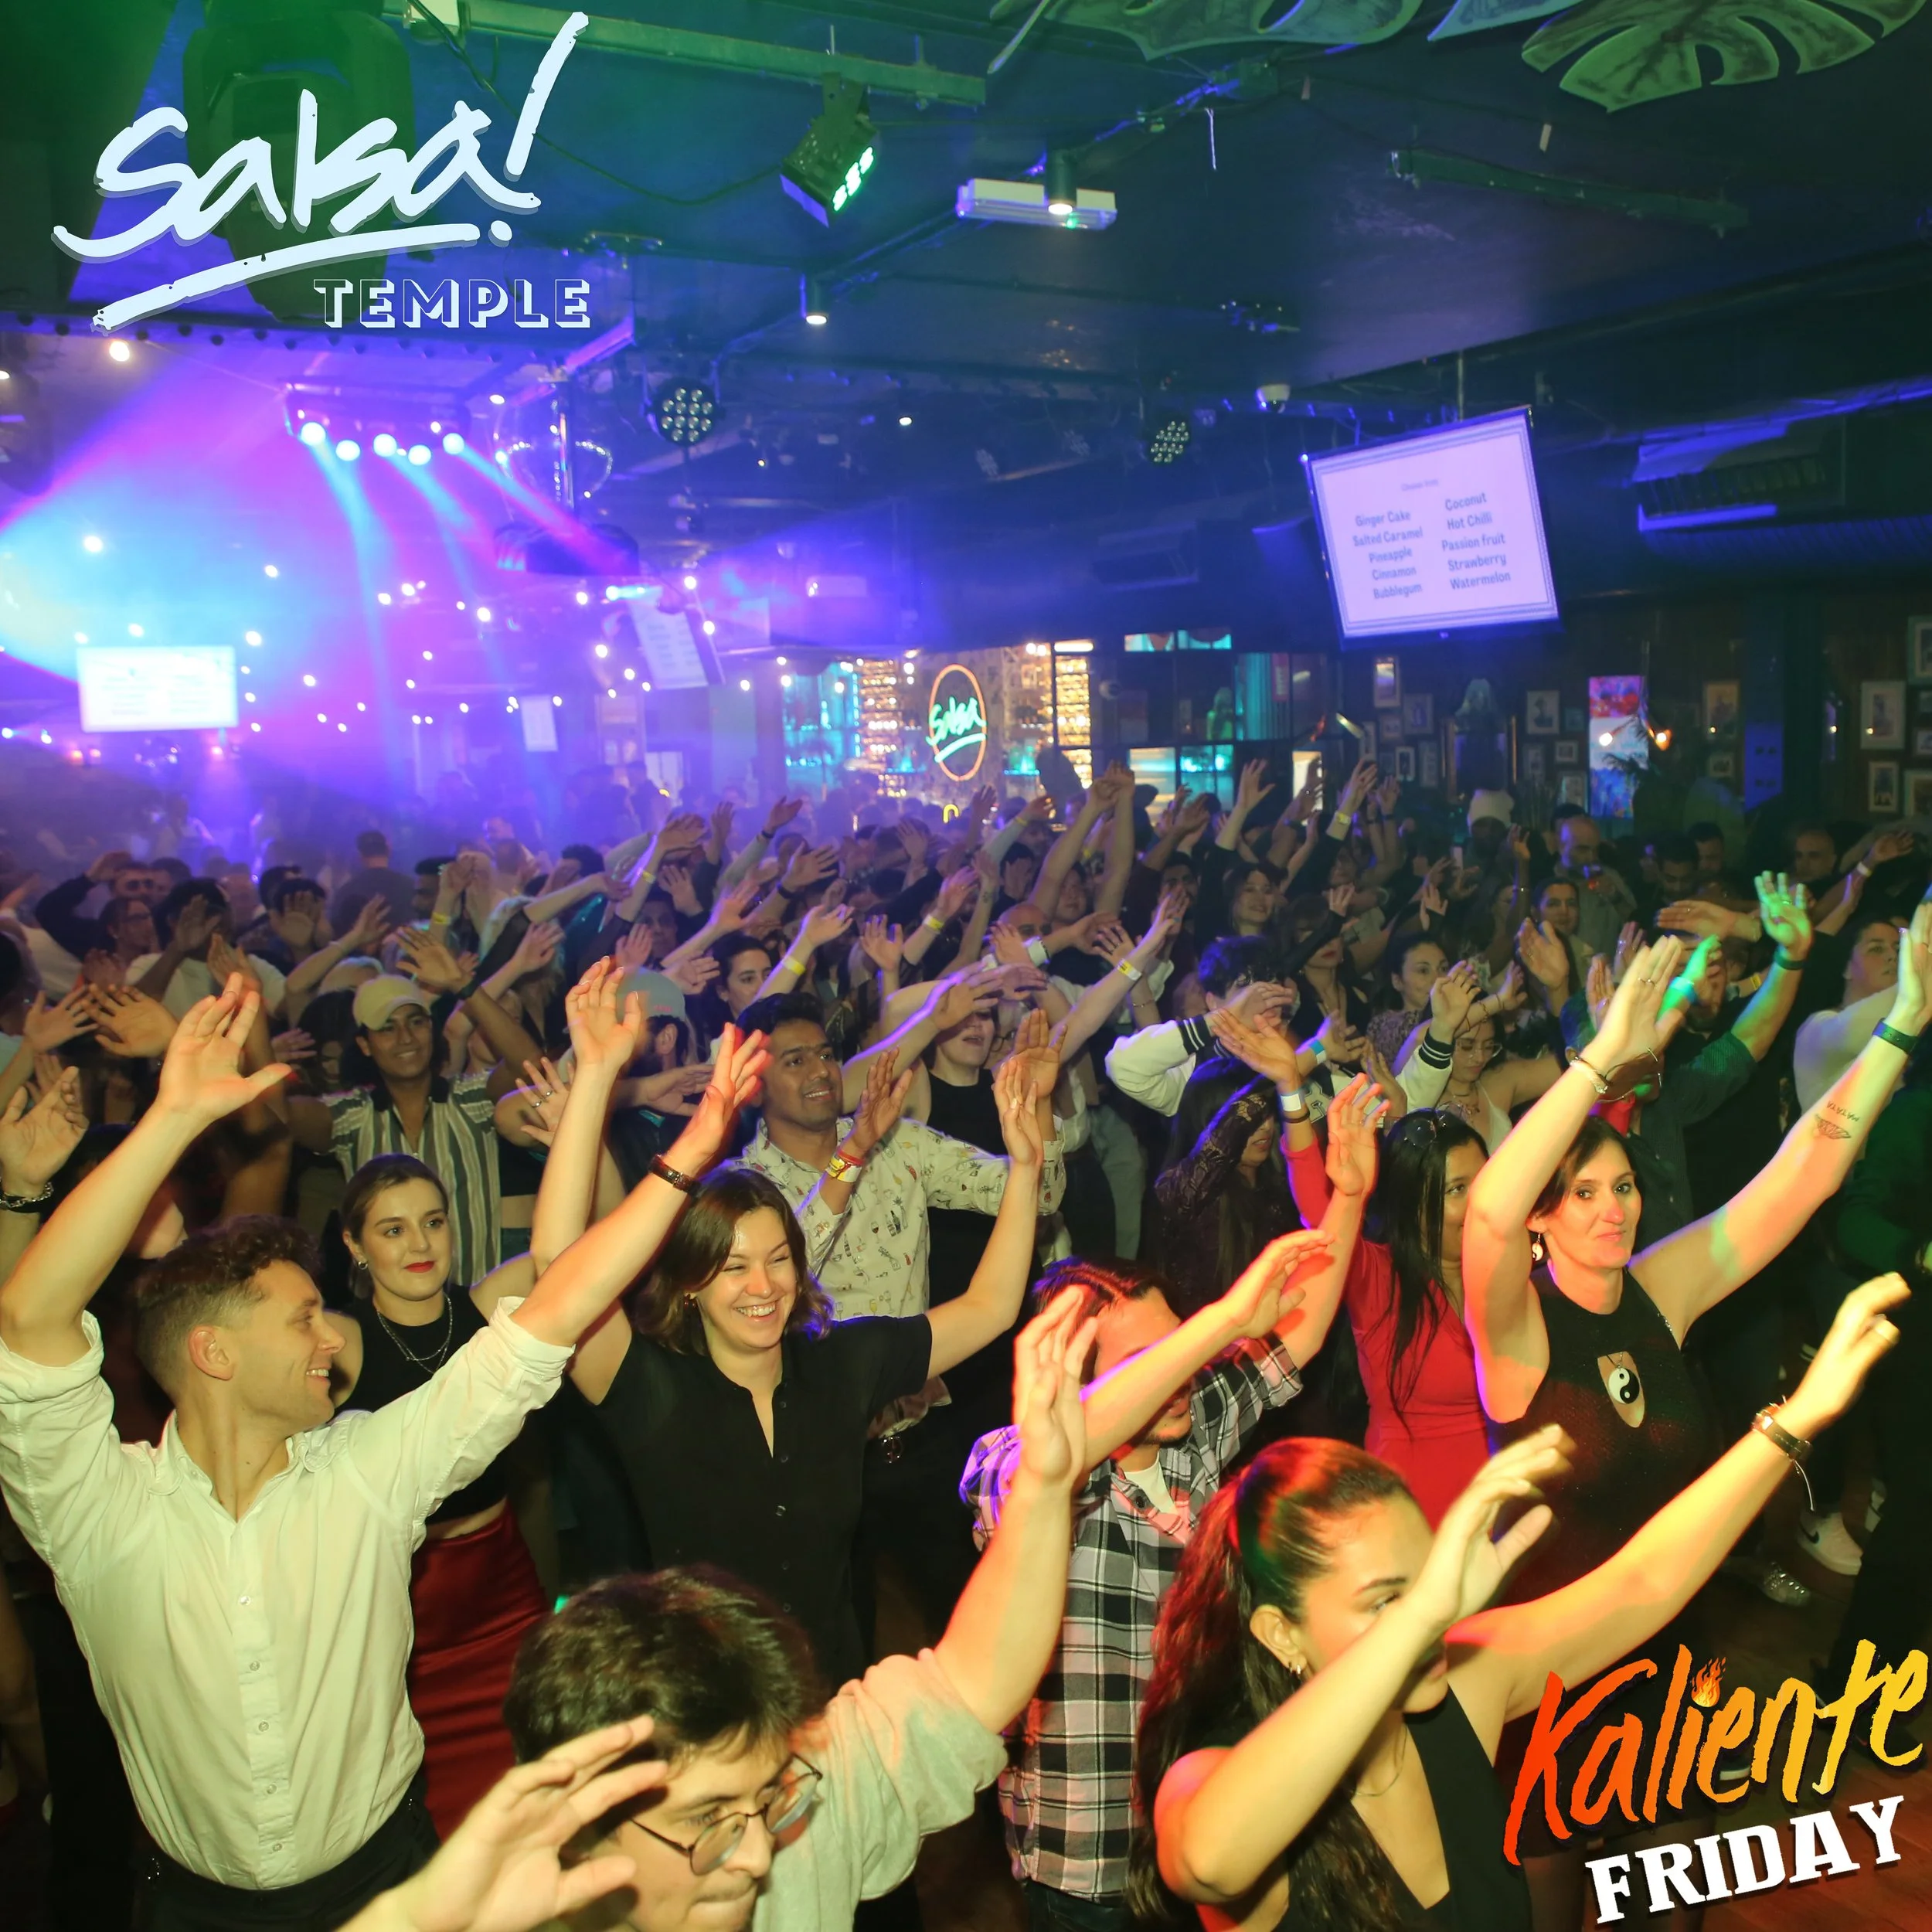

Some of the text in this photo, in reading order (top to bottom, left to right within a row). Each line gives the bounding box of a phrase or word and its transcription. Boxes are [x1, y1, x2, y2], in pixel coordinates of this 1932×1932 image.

[1444, 492, 1488, 512] Coconut
[1355, 509, 1411, 528] Ginger Cake
[1447, 511, 1493, 530] Hot Chilli
[1352, 526, 1423, 547] Salted Caramel
[1441, 532, 1506, 552] Passion fruit
[1368, 546, 1413, 564] Pineapple
[1447, 552, 1507, 572] Strawberry
[1372, 564, 1417, 580] Cinnamon
[1450, 570, 1511, 590] Watermelon
[1373, 582, 1423, 600] Bubblegum
